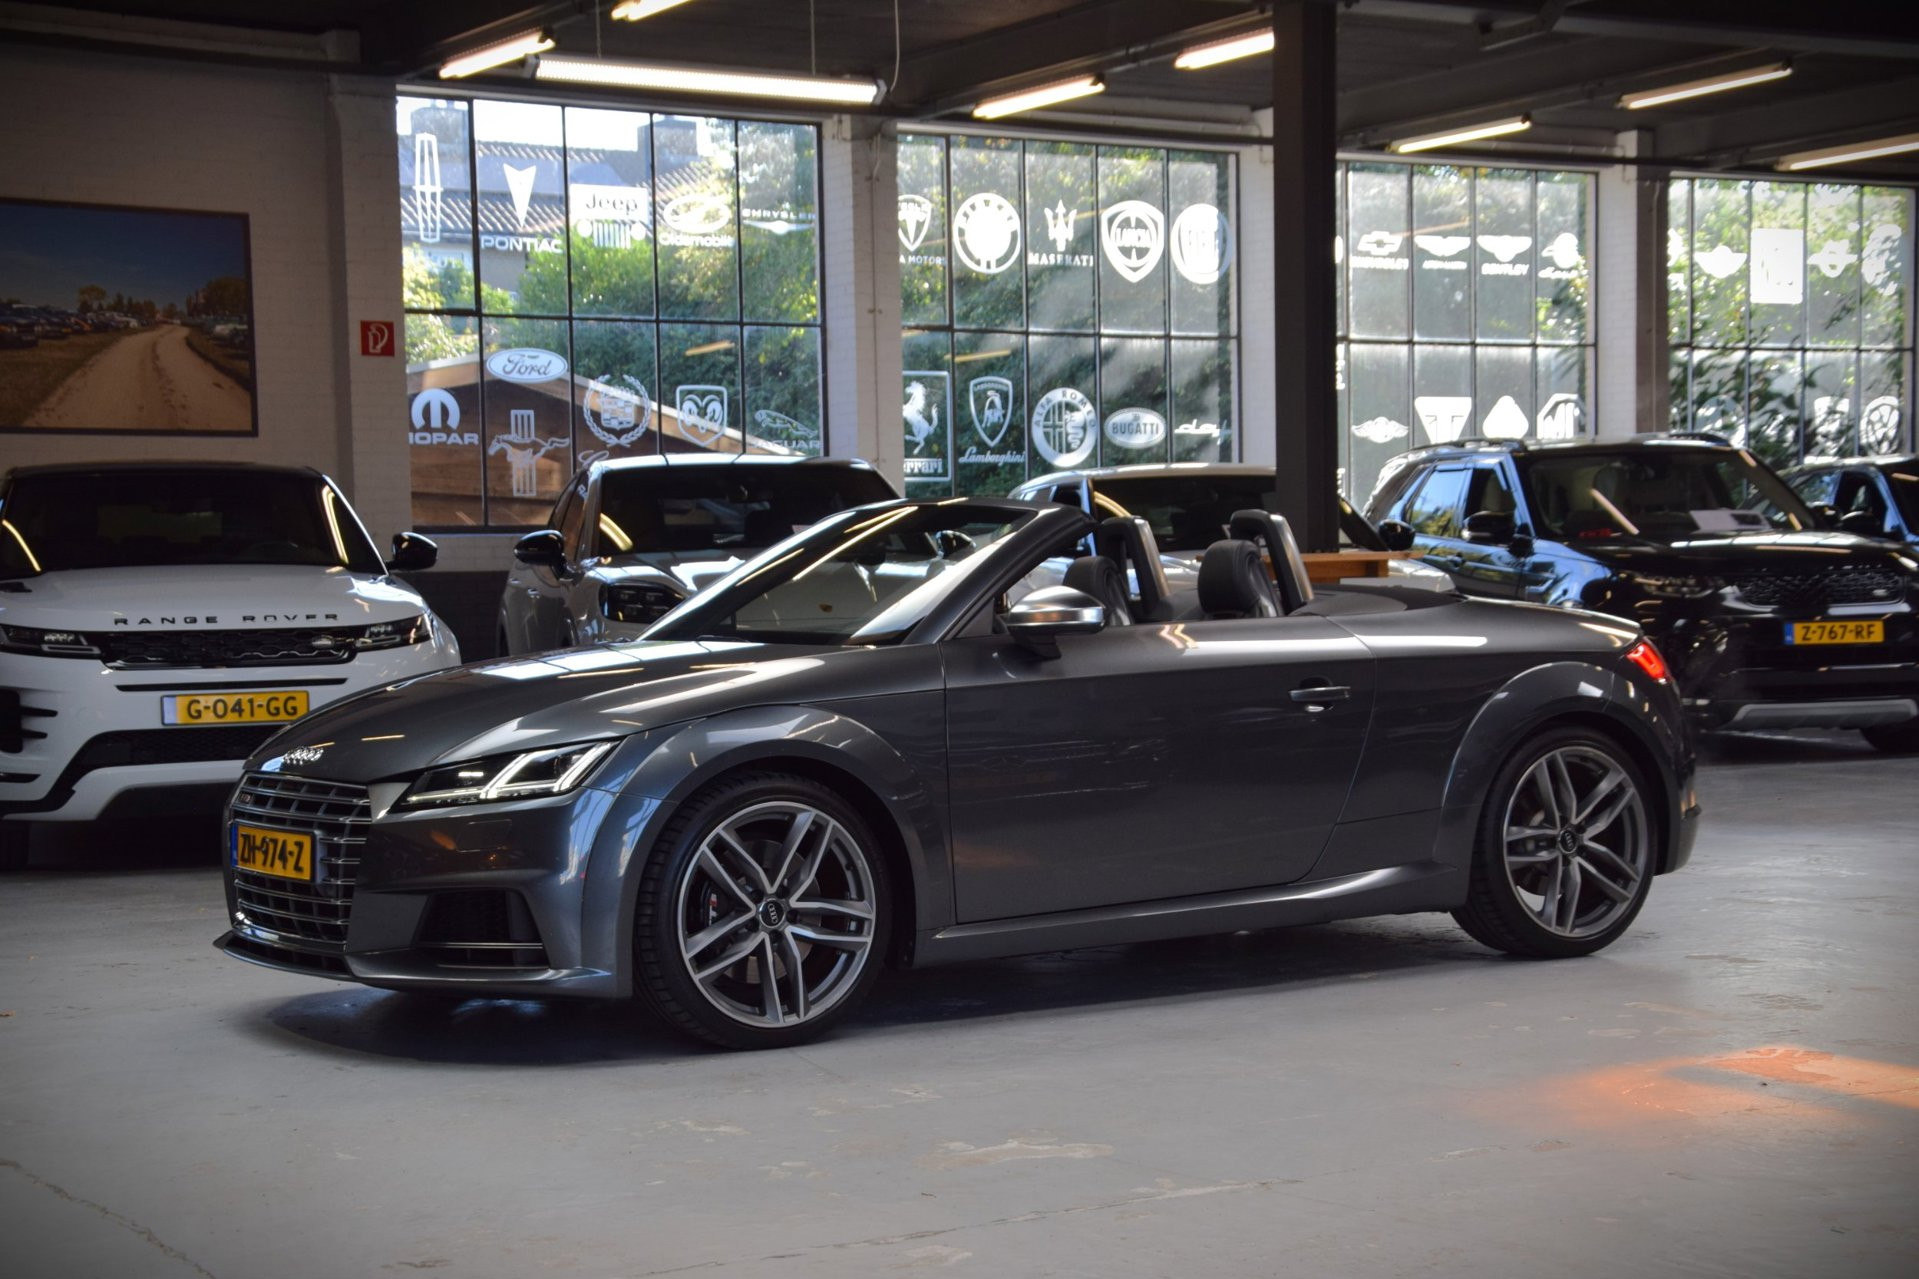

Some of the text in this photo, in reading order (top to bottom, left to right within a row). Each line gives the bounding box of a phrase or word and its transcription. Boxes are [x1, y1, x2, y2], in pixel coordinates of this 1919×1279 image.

[585, 193, 638, 216] Jeep
[480, 235, 563, 253] PONTIAC
[1028, 252, 1093, 266] MASERATI
[502, 353, 552, 376] Ford
[1033, 389, 1096, 429] ALFA ROMEO
[1111, 421, 1160, 435] BUGATTI
[958, 446, 1027, 467] Lamborghini
[114, 613, 339, 626] RANGE ROVER
[1801, 623, 1876, 641] Z-767-RF
[186, 695, 298, 720] G-041-GG
[240, 832, 305, 873] ZH-974-Z
